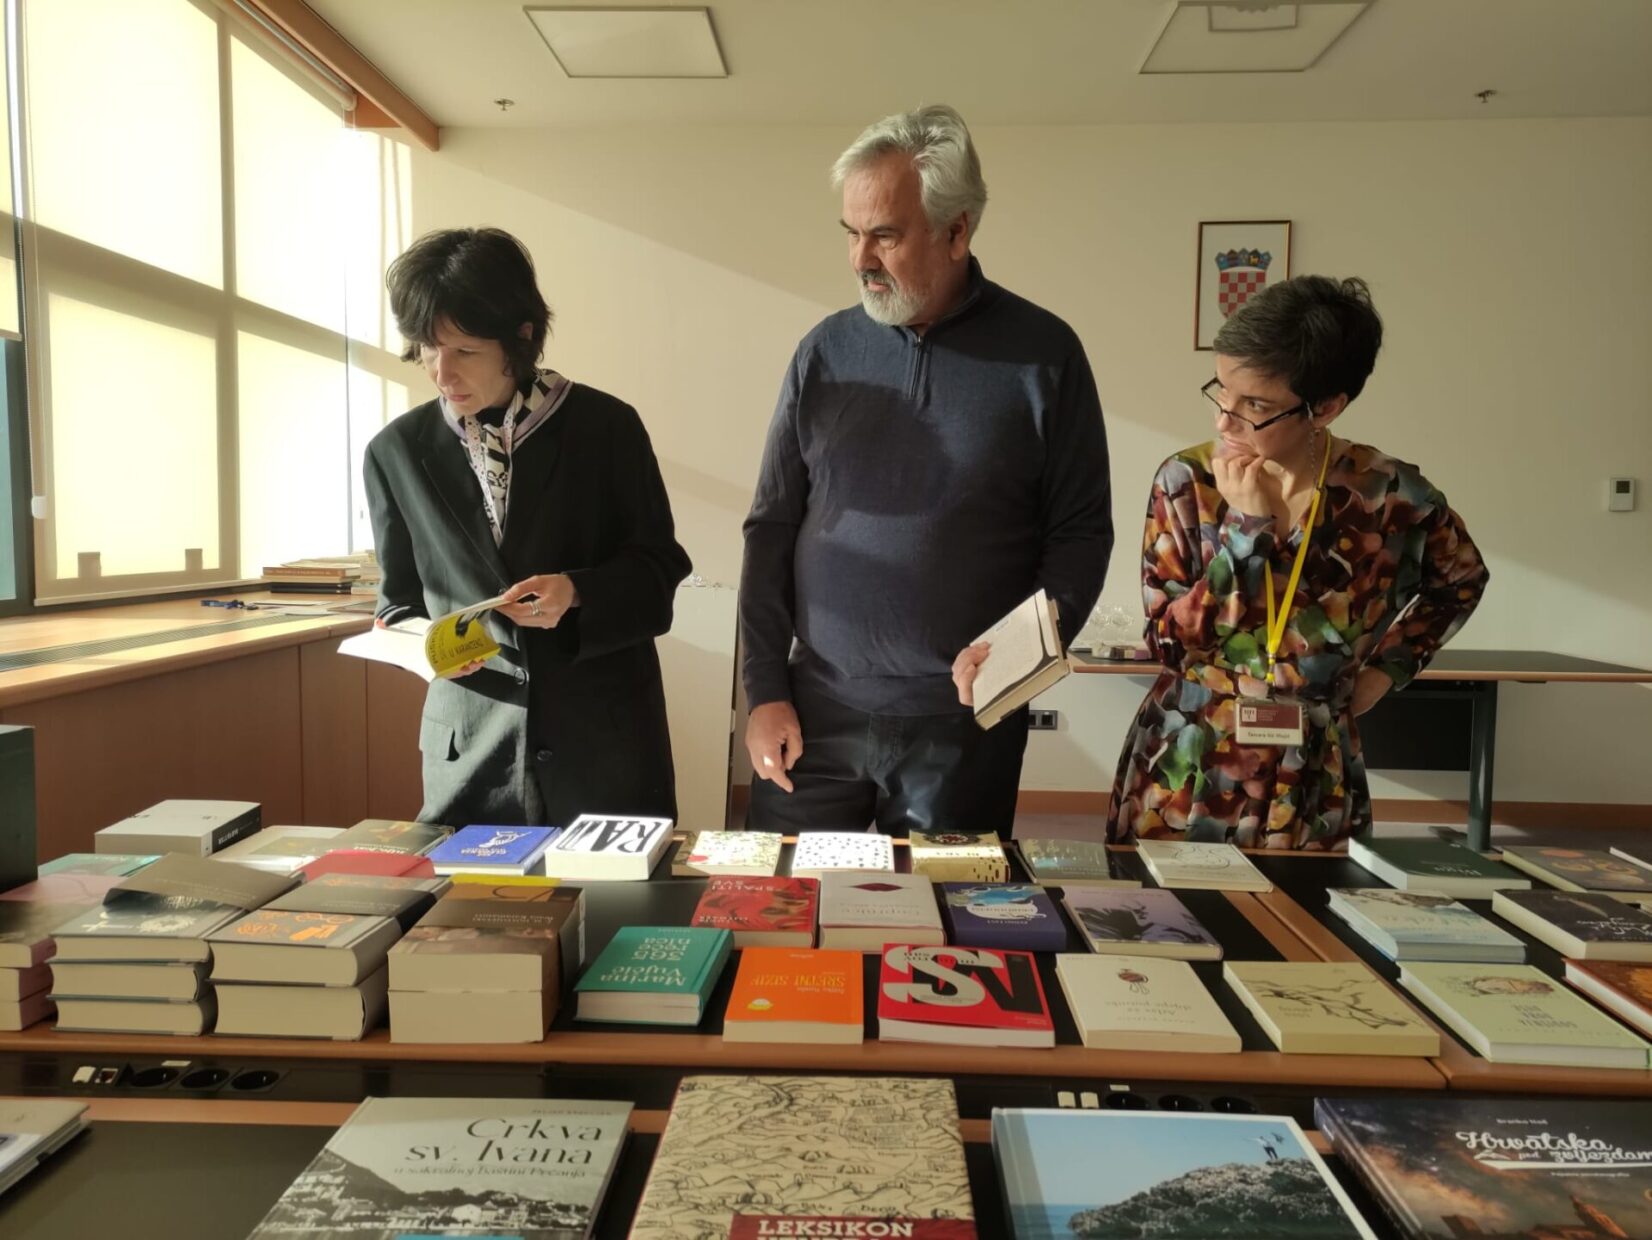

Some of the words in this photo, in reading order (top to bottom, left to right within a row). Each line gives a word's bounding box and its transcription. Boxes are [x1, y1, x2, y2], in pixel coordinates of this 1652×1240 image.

[600, 974, 686, 987] Marina
[467, 1118, 602, 1141] Crkva
[404, 1145, 458, 1162] sv.
[477, 1139, 593, 1165] Ivana
[1455, 1131, 1613, 1152] Hrvatska
[757, 1219, 914, 1238] LEKSIKON
